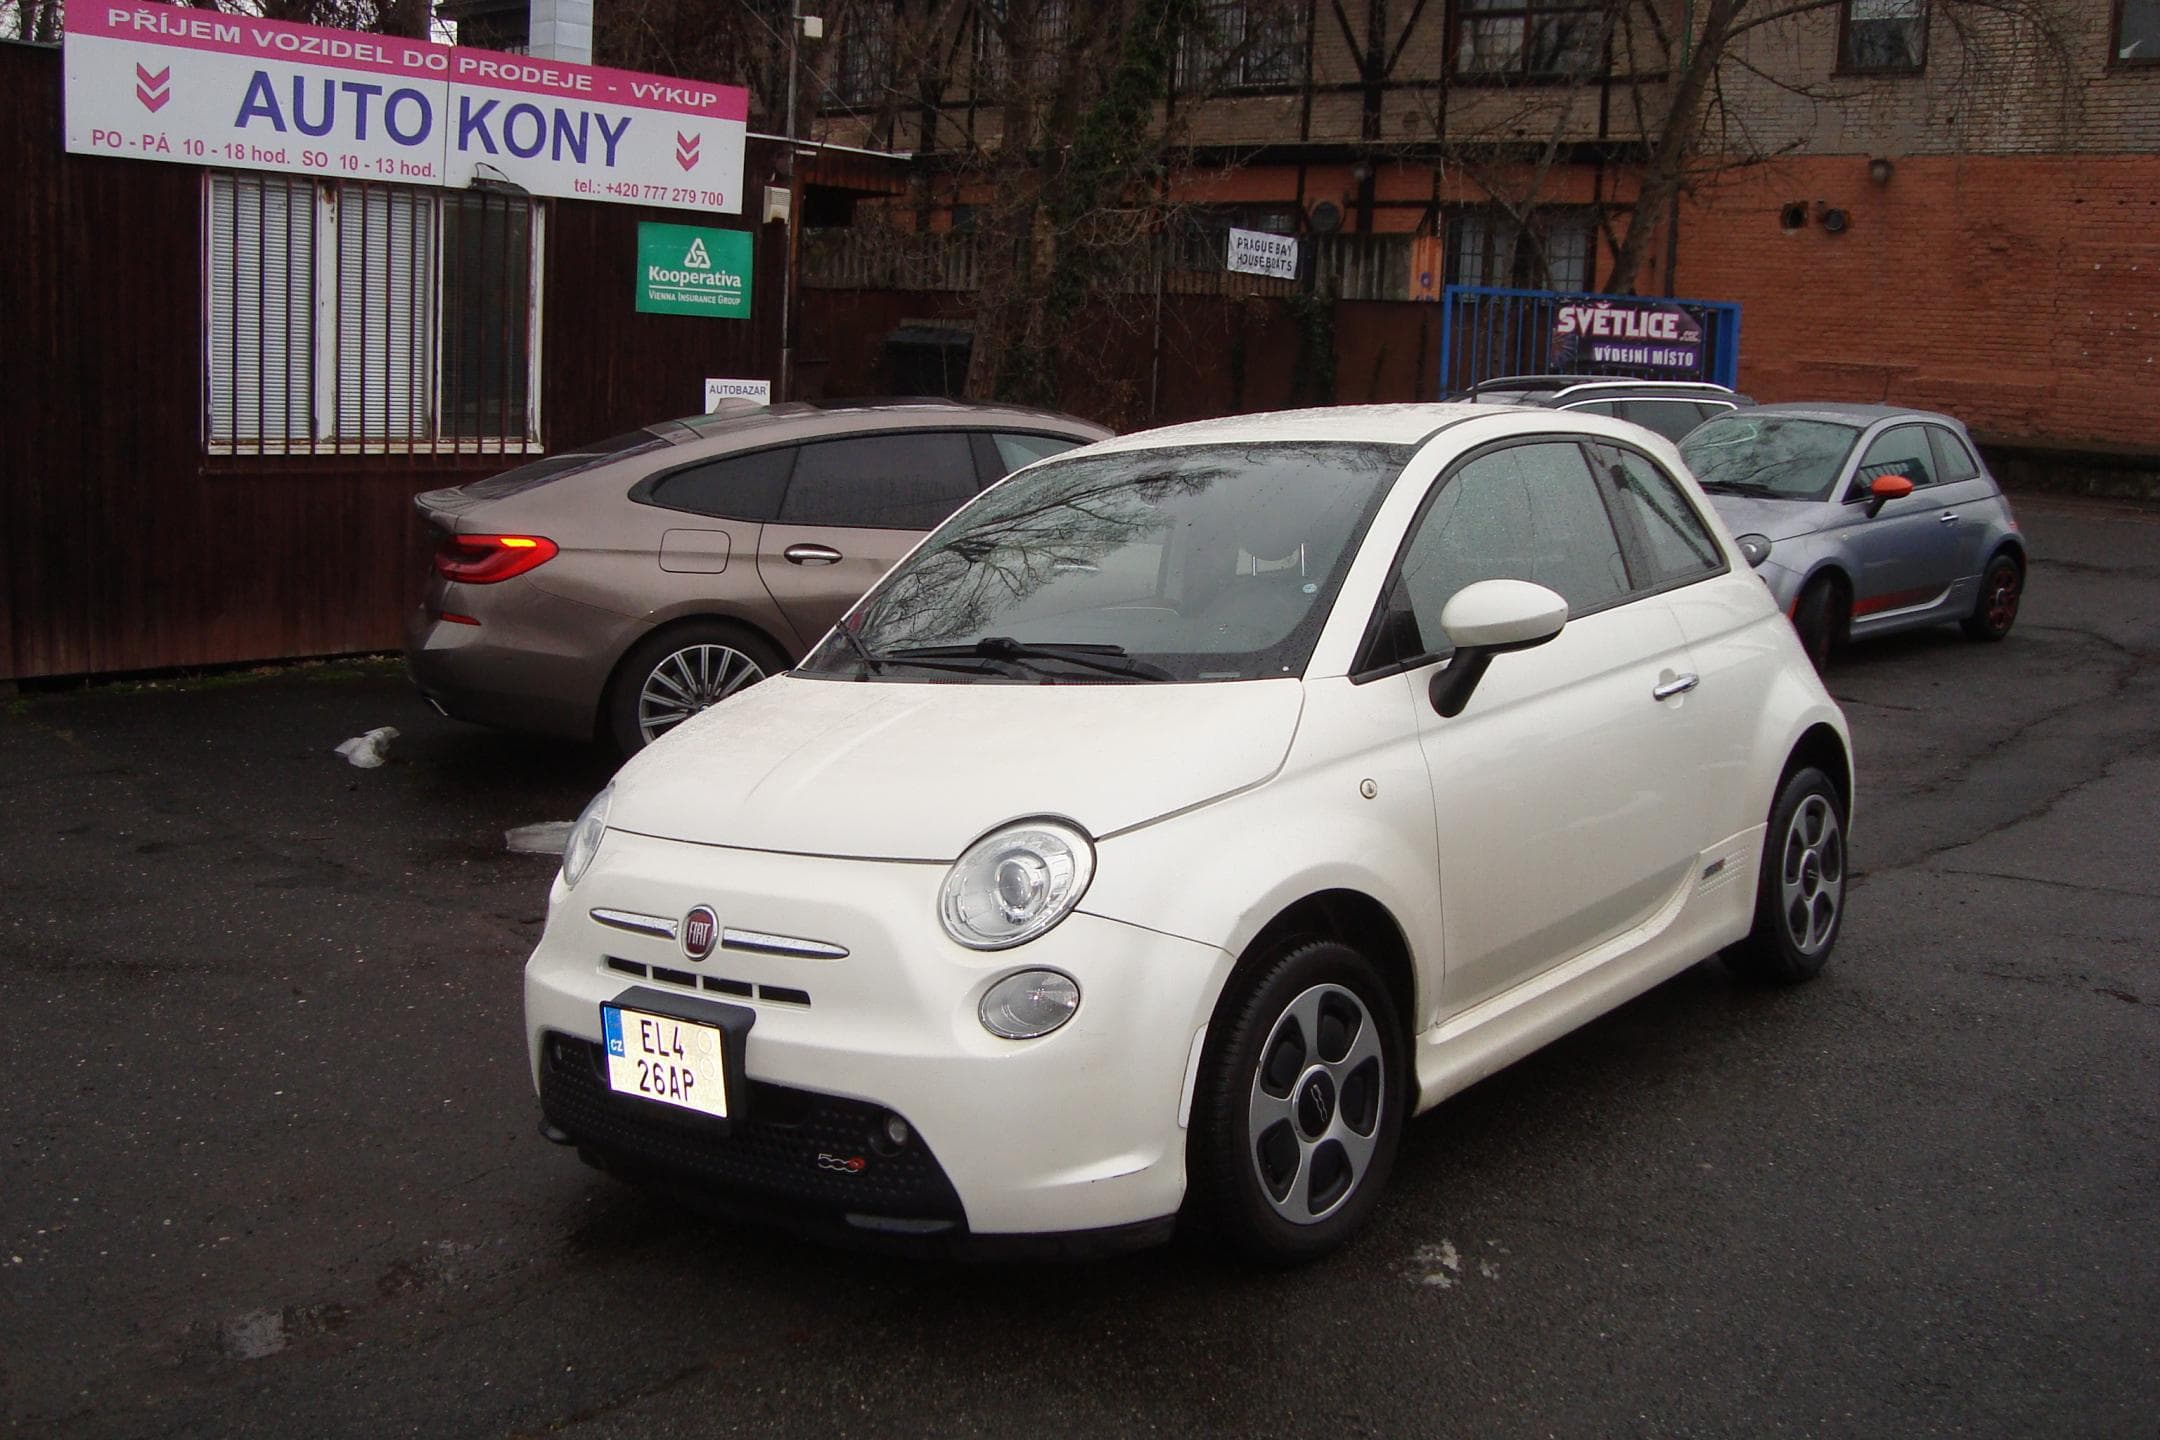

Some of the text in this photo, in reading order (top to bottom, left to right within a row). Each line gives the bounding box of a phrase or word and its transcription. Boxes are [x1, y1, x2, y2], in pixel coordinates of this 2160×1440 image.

[107, 8, 241, 44] PŘÍJEM
[251, 29, 394, 65] VOZIDEL
[403, 50, 449, 71] DO
[459, 57, 593, 91] PRODEJE
[630, 81, 718, 108] VÝKUP
[234, 70, 632, 167] AUTO KONY
[92, 129, 122, 149] PO
[142, 132, 170, 153] PÁ
[184, 139, 204, 157] 10
[224, 143, 245, 160] 18
[252, 145, 290, 164] hod.
[302, 150, 328, 168] SO
[340, 154, 358, 171] 10
[376, 157, 394, 175] 13
[401, 160, 436, 178] hod.
[574, 178, 723, 207] tel.: +420 777 279 700
[1237, 236, 1292, 257] PRAGUE BAY
[1237, 253, 1292, 272] HOUSEBOATS
[649, 265, 741, 287] Kooperativa
[1594, 344, 1694, 367] VÝDEJNÍ MÍSTO
[709, 384, 766, 396] AUTOBAZAR
[687, 920, 711, 946] FIAT
[610, 1039, 624, 1053] CZ
[641, 1019, 685, 1061] EL4
[637, 1058, 694, 1102] 26AP
